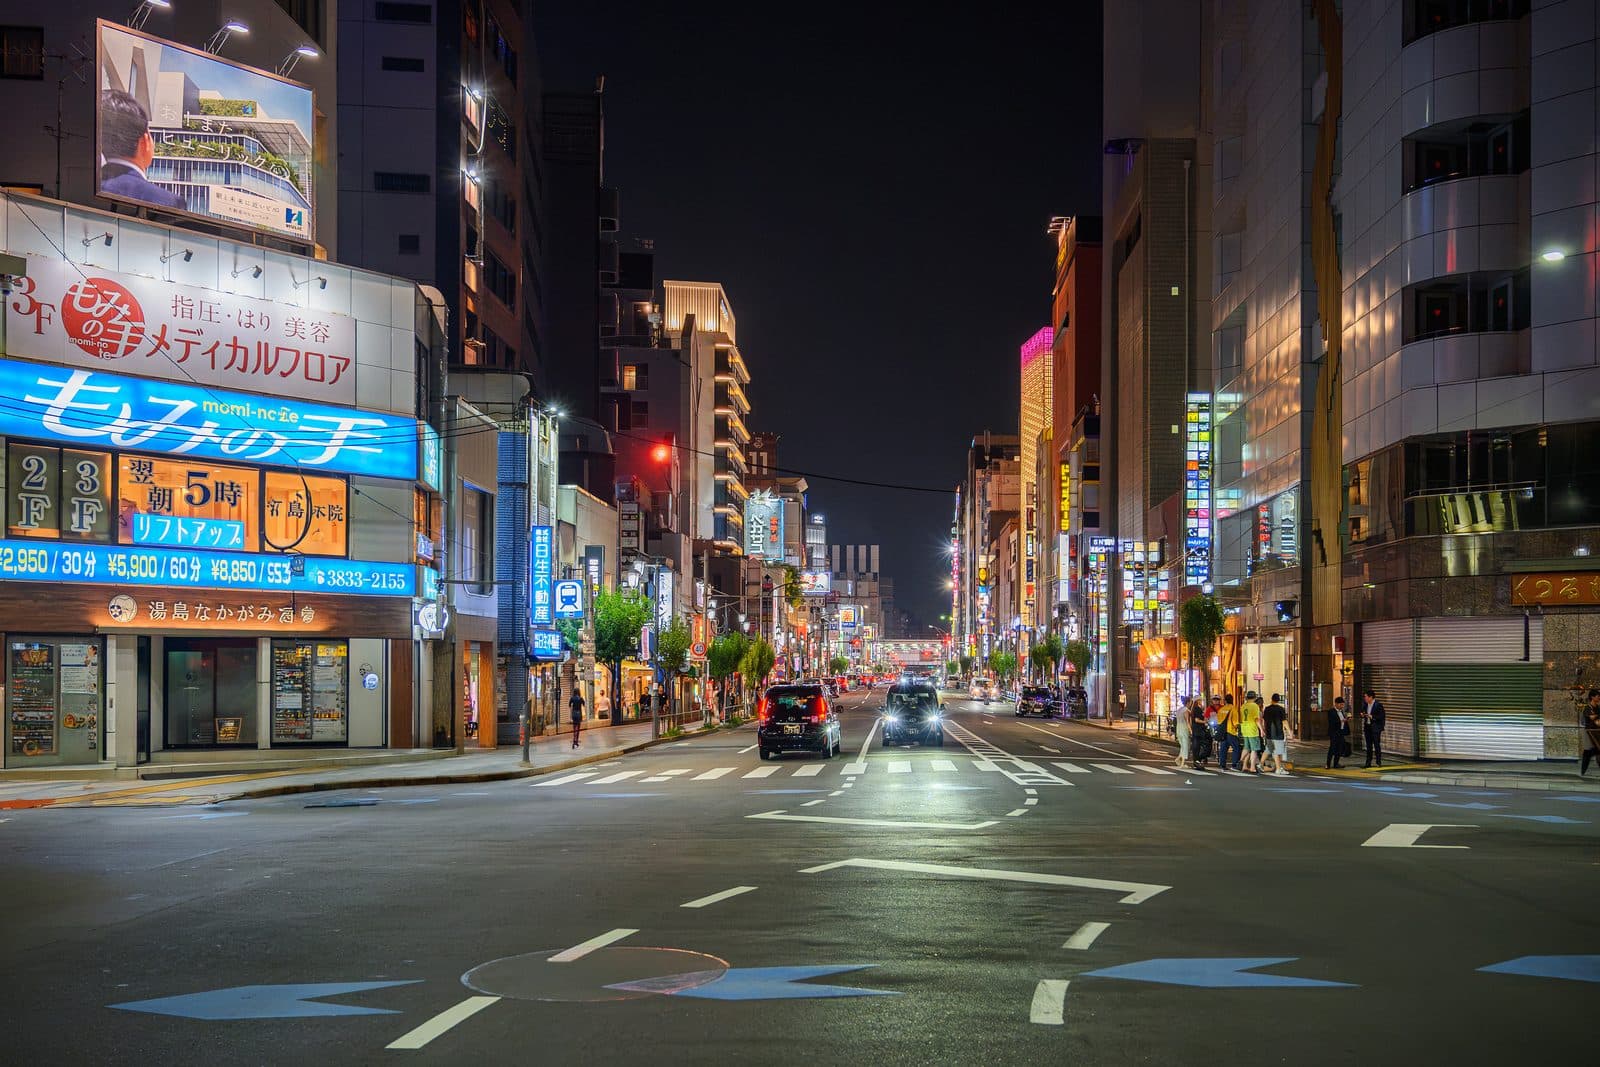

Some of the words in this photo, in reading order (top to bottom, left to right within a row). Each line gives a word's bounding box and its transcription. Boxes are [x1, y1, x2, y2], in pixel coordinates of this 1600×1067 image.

[171, 294, 271, 332] 指圧・はり
[284, 317, 331, 344] 美容
[145, 323, 351, 386] メディカルフロア
[138, 516, 243, 546] リフトアップ
[327, 569, 406, 590] 3833-2155
